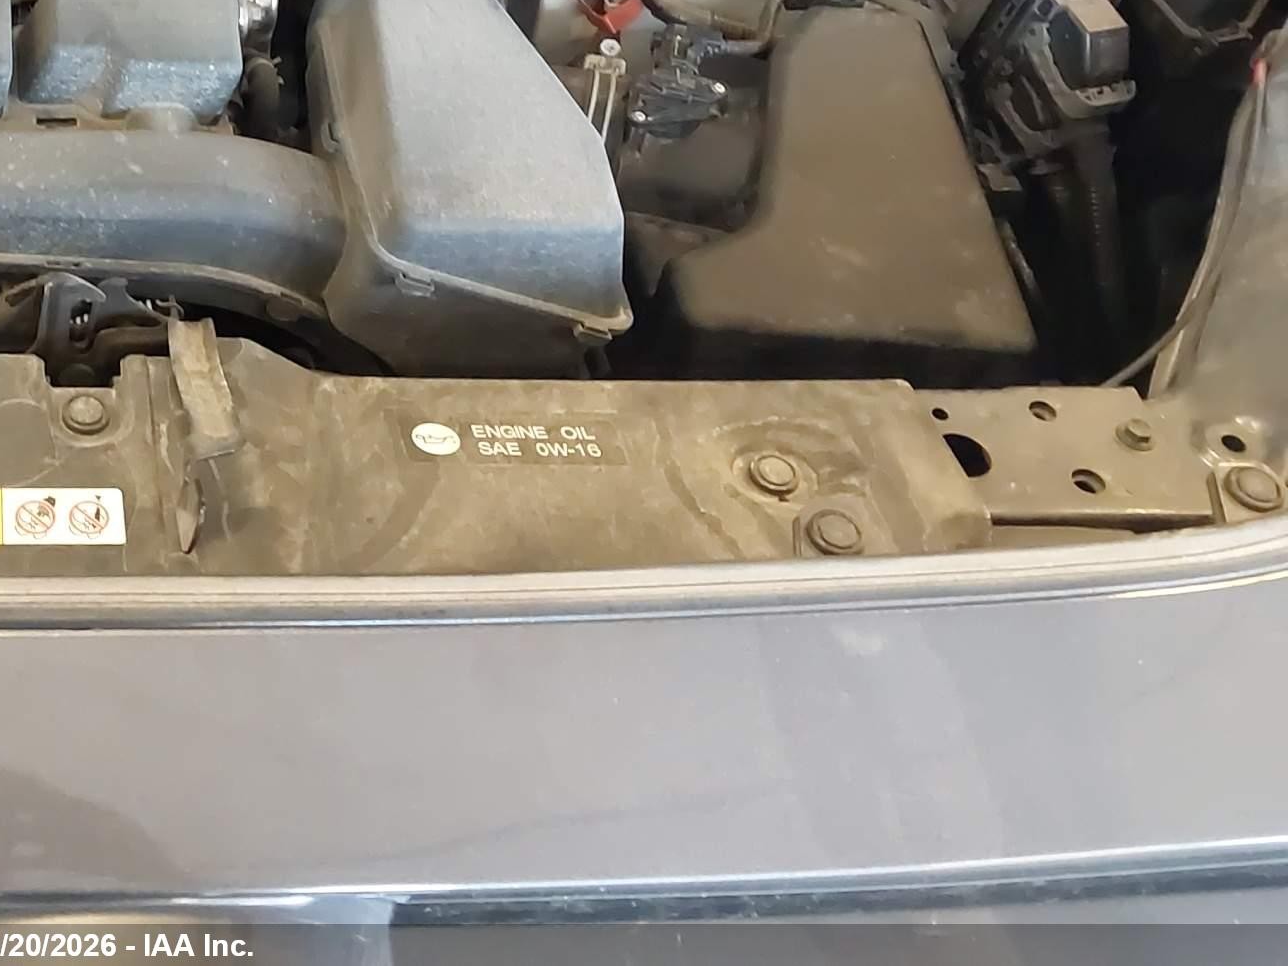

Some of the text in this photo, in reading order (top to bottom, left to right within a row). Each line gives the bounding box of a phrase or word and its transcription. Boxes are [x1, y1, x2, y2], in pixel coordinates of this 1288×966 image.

[470, 424, 597, 441] ENGINE OIL
[478, 441, 602, 458] SAE 0W-16
